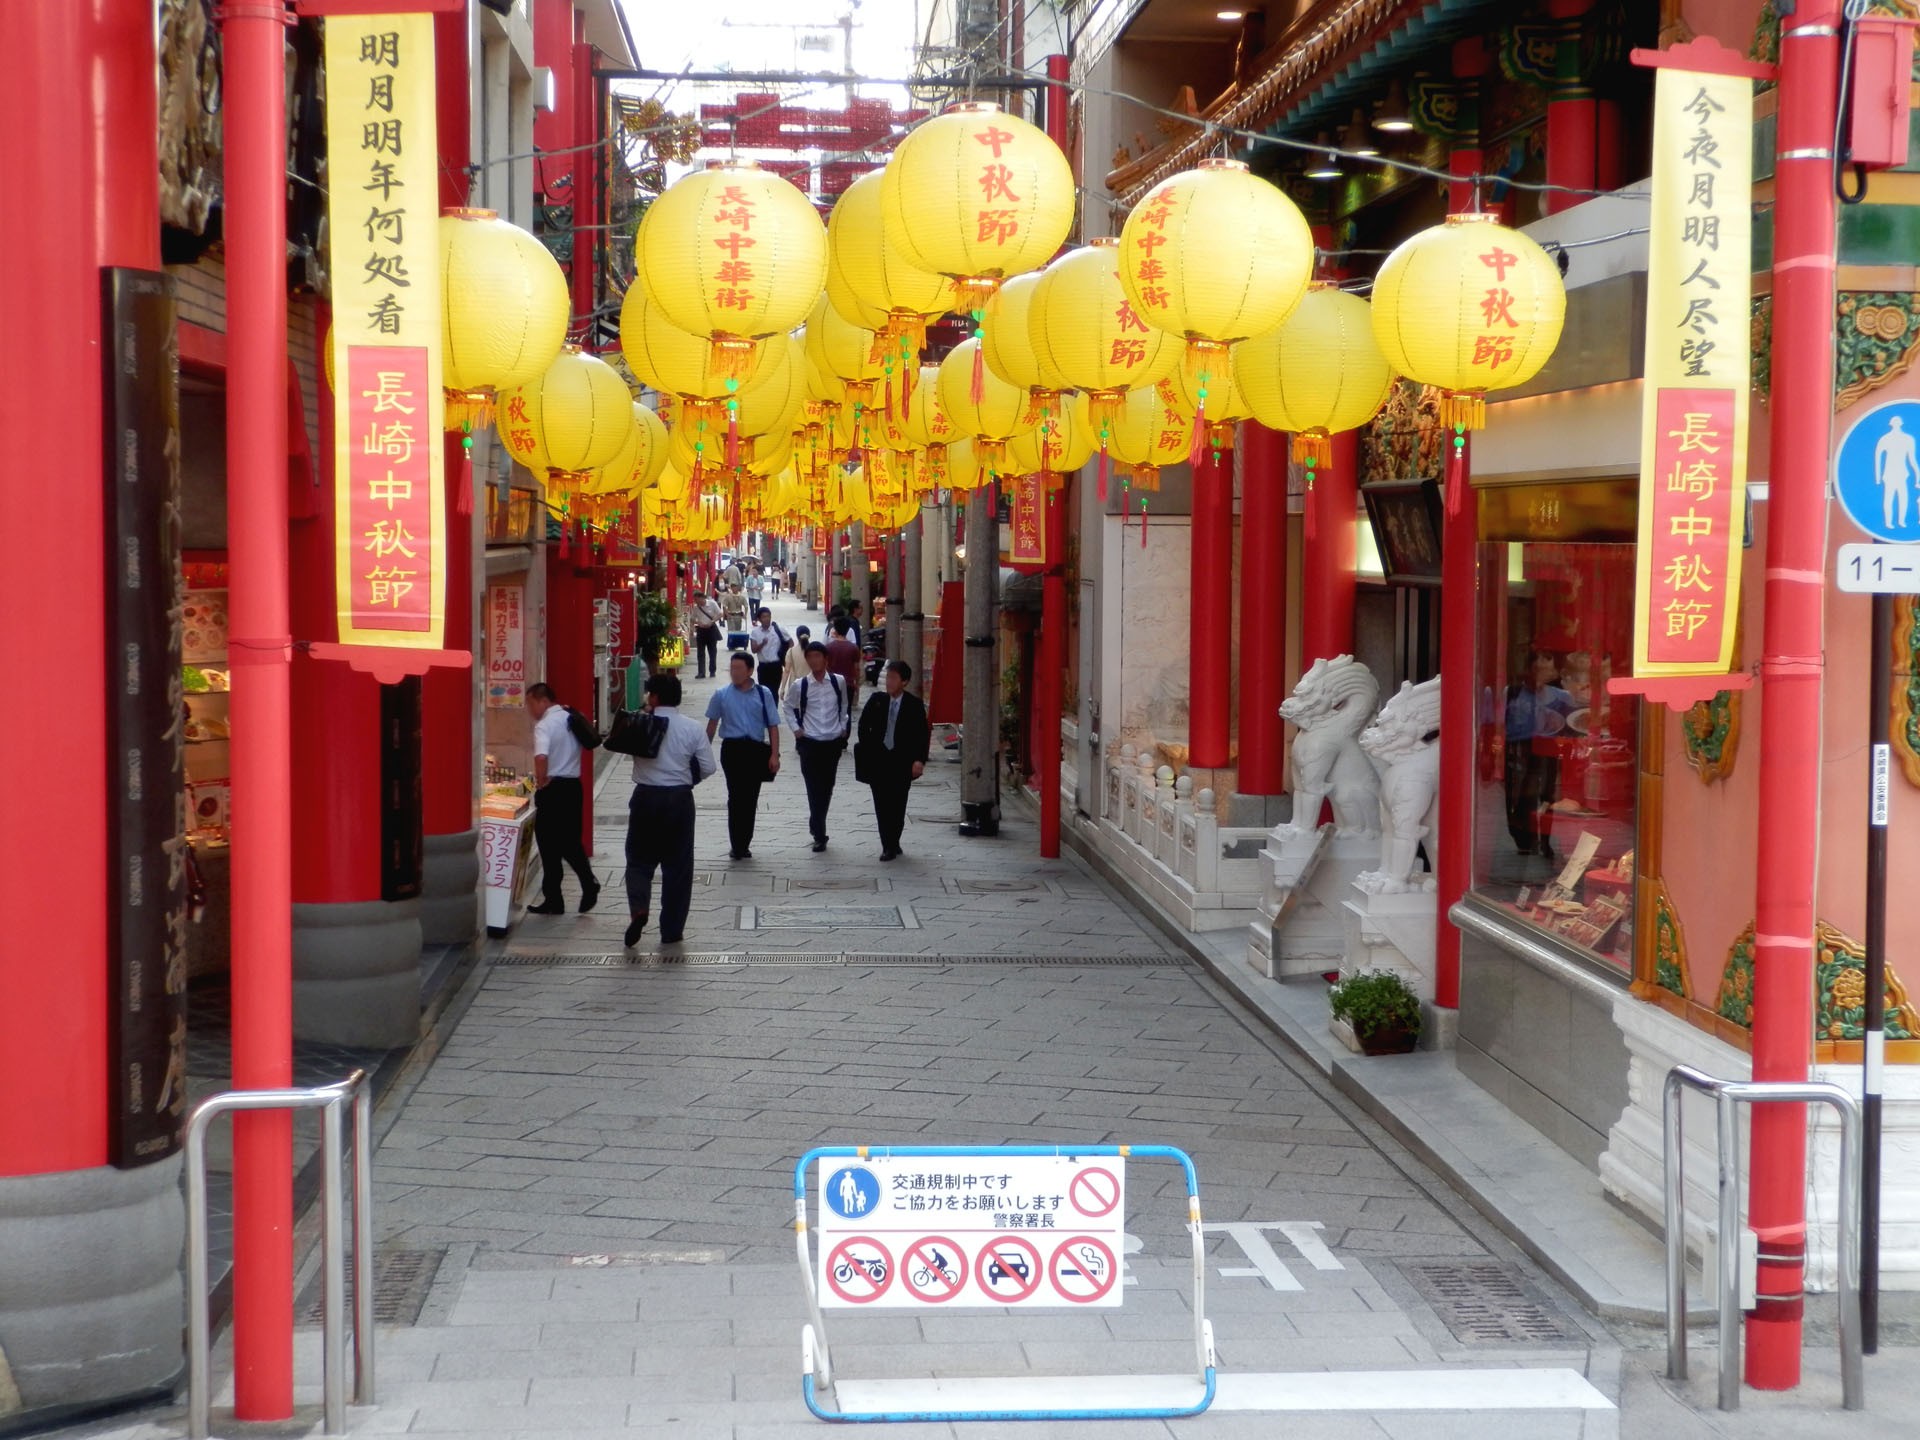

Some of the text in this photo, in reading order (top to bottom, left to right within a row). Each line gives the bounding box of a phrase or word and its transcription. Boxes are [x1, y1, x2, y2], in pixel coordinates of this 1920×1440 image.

[359, 31, 411, 335] 明月明年何処看
[973, 126, 1020, 246] 中秋節
[1677, 87, 1725, 376] 今夜月明人尽望
[713, 186, 756, 311] 長崎中華街
[1137, 186, 1178, 309] 長崎中華街
[1472, 246, 1519, 370] 中秋節
[1109, 271, 1150, 369] 秋節
[362, 371, 416, 608] 長崎中秋節
[1663, 413, 1720, 640] 長崎中秋節
[491, 660, 522, 672] 600
[892, 1174, 1013, 1190] 交通規制中です
[893, 1194, 1065, 1211] ご協力をお願いします
[993, 1213, 1055, 1228] 警察署長
